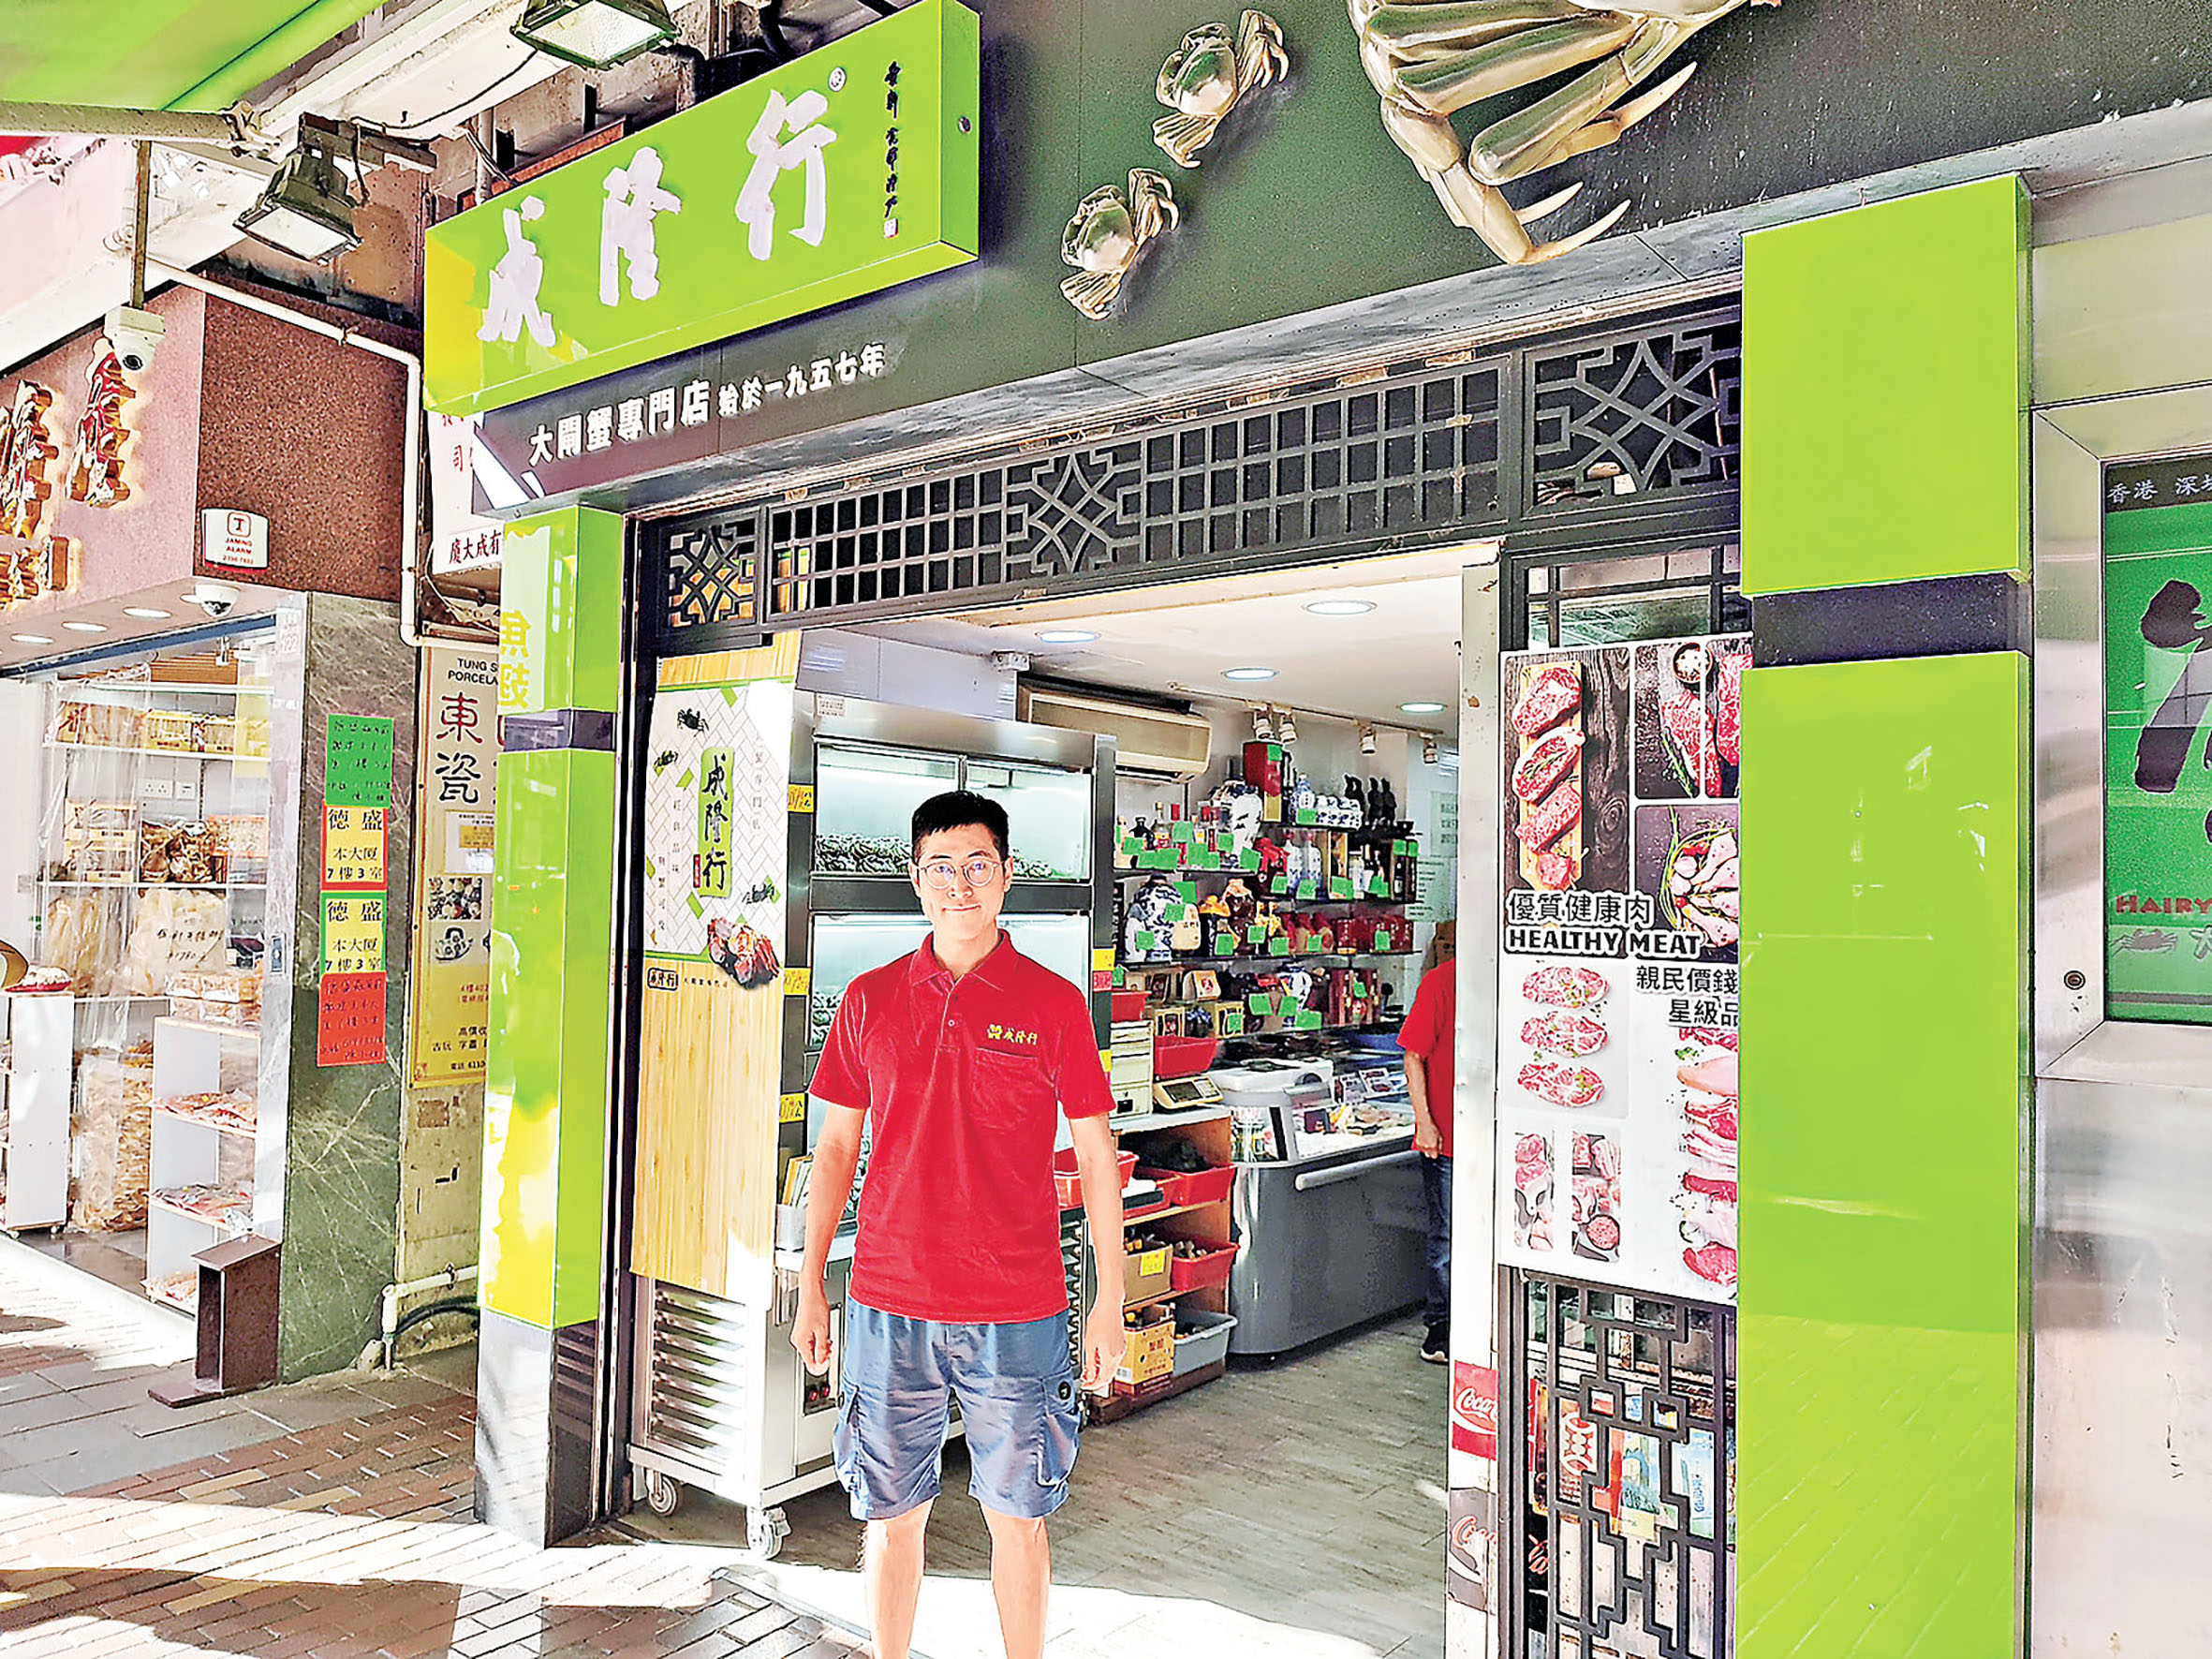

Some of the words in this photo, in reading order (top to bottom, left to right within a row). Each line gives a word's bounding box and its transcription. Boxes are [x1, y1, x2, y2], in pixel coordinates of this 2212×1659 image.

[528, 378, 712, 467] 大閘蟹專門店
[717, 341, 886, 418] 始於一九五七年
[2107, 480, 2158, 504] 香港
[457, 658, 487, 672] TUNG
[1509, 893, 1651, 925] 優質健康肉
[2116, 895, 2212, 914] HAIRY
[1509, 928, 1621, 952] HEALTHY
[1630, 932, 1701, 955] MEAT
[1636, 965, 1738, 996] 親民價錢
[1669, 999, 1739, 1028] 星級品
